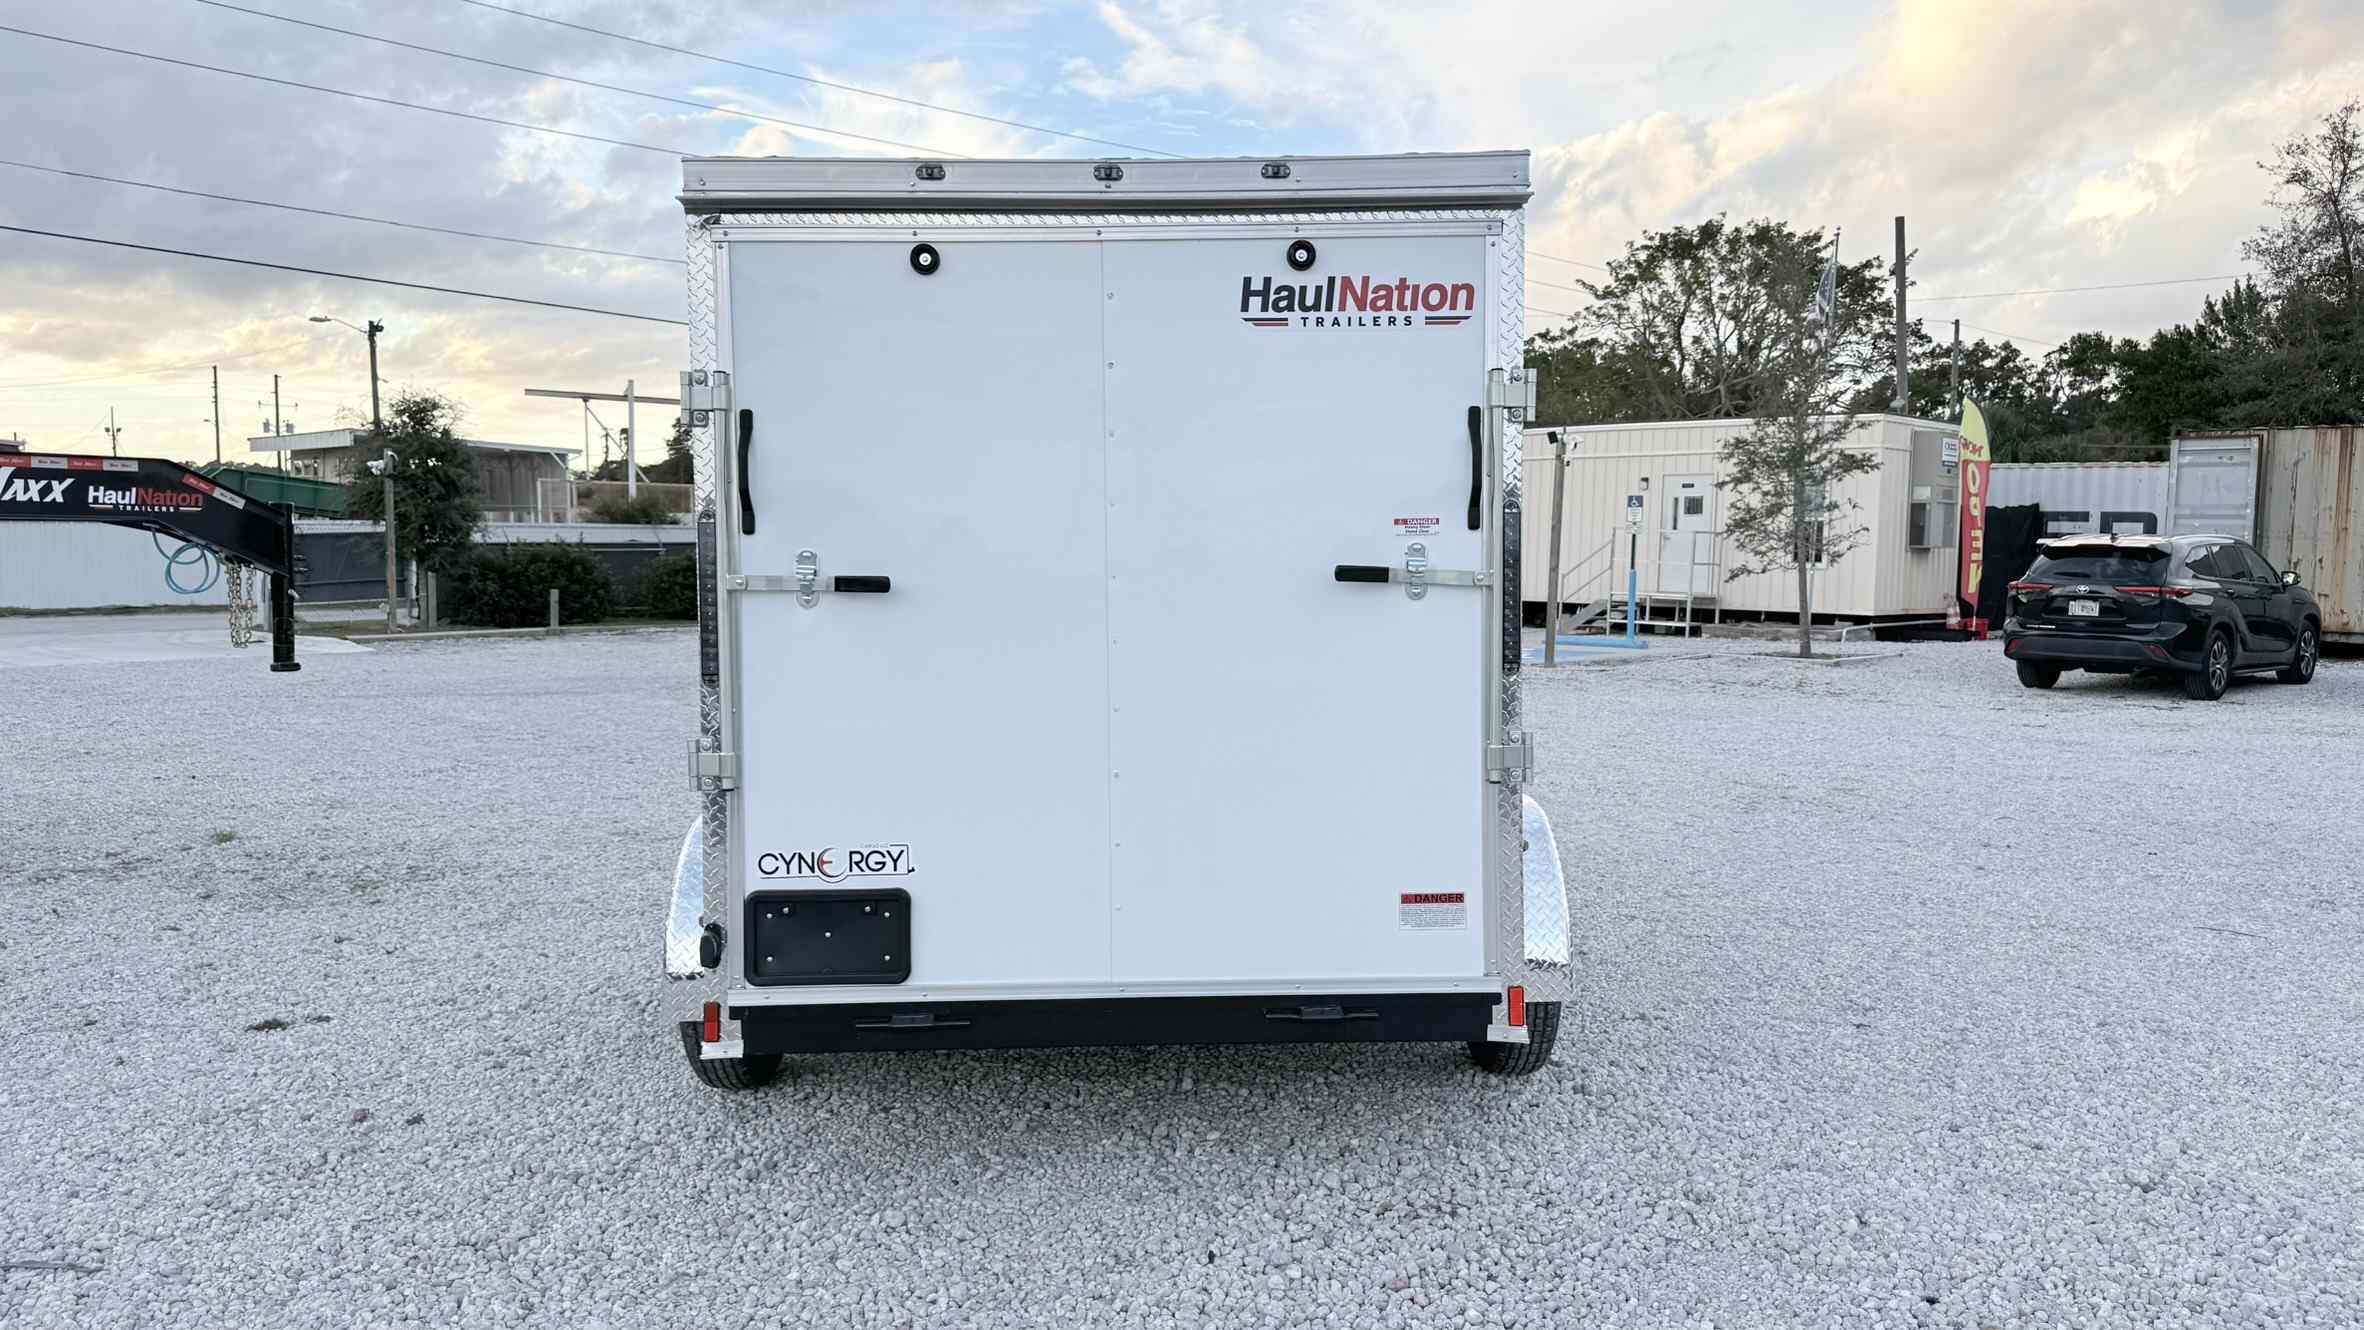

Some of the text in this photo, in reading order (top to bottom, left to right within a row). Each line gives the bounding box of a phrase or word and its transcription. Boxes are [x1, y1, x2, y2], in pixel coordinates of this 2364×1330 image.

[1240, 275, 1475, 313] HaulNation
[1300, 316, 1413, 328] TRAILERS
[88, 485, 203, 507] HaulNation
[119, 505, 175, 513] TRAILERS
[758, 848, 904, 878] CYNERGY
[1414, 894, 1464, 904] DANGER
